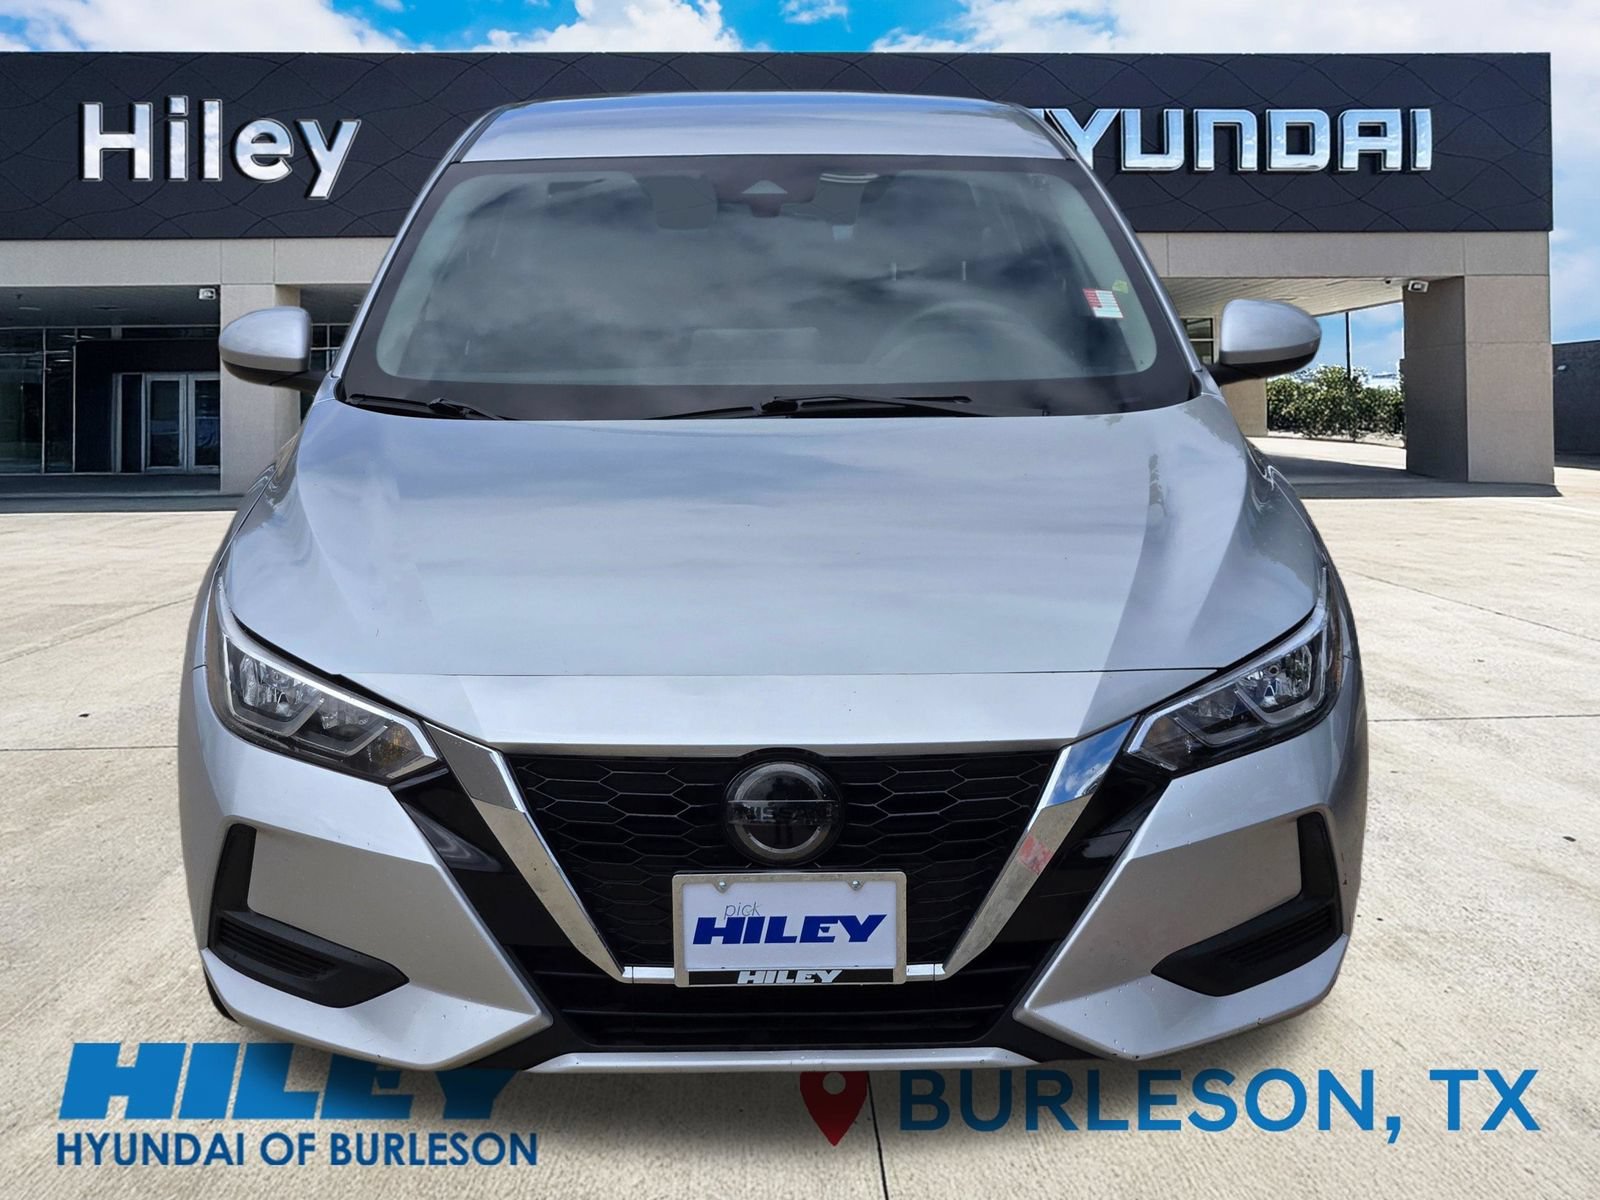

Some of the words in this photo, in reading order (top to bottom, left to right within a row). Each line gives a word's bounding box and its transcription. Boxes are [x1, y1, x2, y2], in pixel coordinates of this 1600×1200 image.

[81, 96, 361, 199] Hiley
[1029, 108, 1433, 171] YUNDAI
[724, 902, 761, 919] pick
[693, 914, 887, 944] HILEY
[737, 969, 843, 984] HILEY
